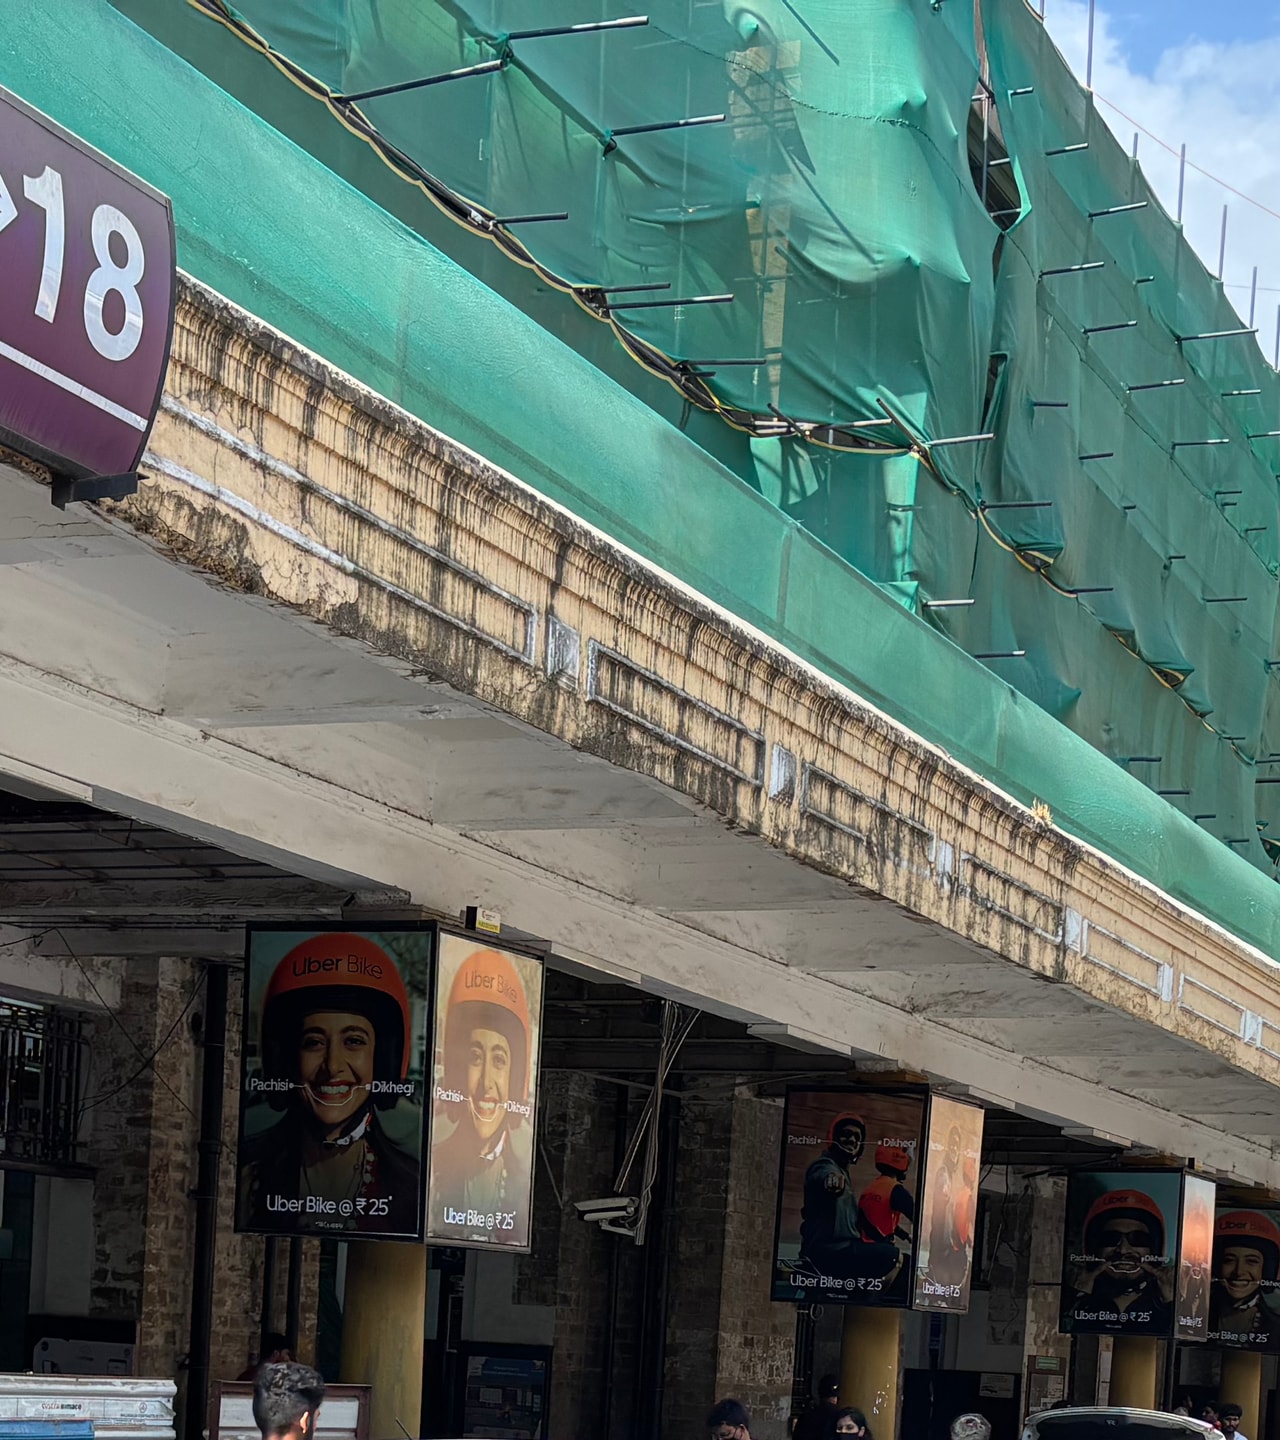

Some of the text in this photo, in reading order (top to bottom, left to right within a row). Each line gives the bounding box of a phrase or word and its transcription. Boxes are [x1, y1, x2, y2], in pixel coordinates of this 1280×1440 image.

[23, 165, 145, 362] 18
[292, 954, 383, 980] Uber Bike
[464, 971, 495, 990] Uber
[250, 1078, 289, 1092] Pachisi
[371, 1081, 415, 1094] Dikhegi
[436, 1087, 461, 1102] Pachisi
[787, 1135, 817, 1145] Pachisi
[266, 1194, 304, 1213] Uber
[306, 1195, 336, 1214] Bike
[338, 1198, 354, 1217] @
[443, 1206, 466, 1226] Uber
[466, 1208, 485, 1227] Bike
[790, 1274, 818, 1287] Uber
[819, 1275, 843, 1289] Bike
[1074, 1310, 1098, 1320] Uber
